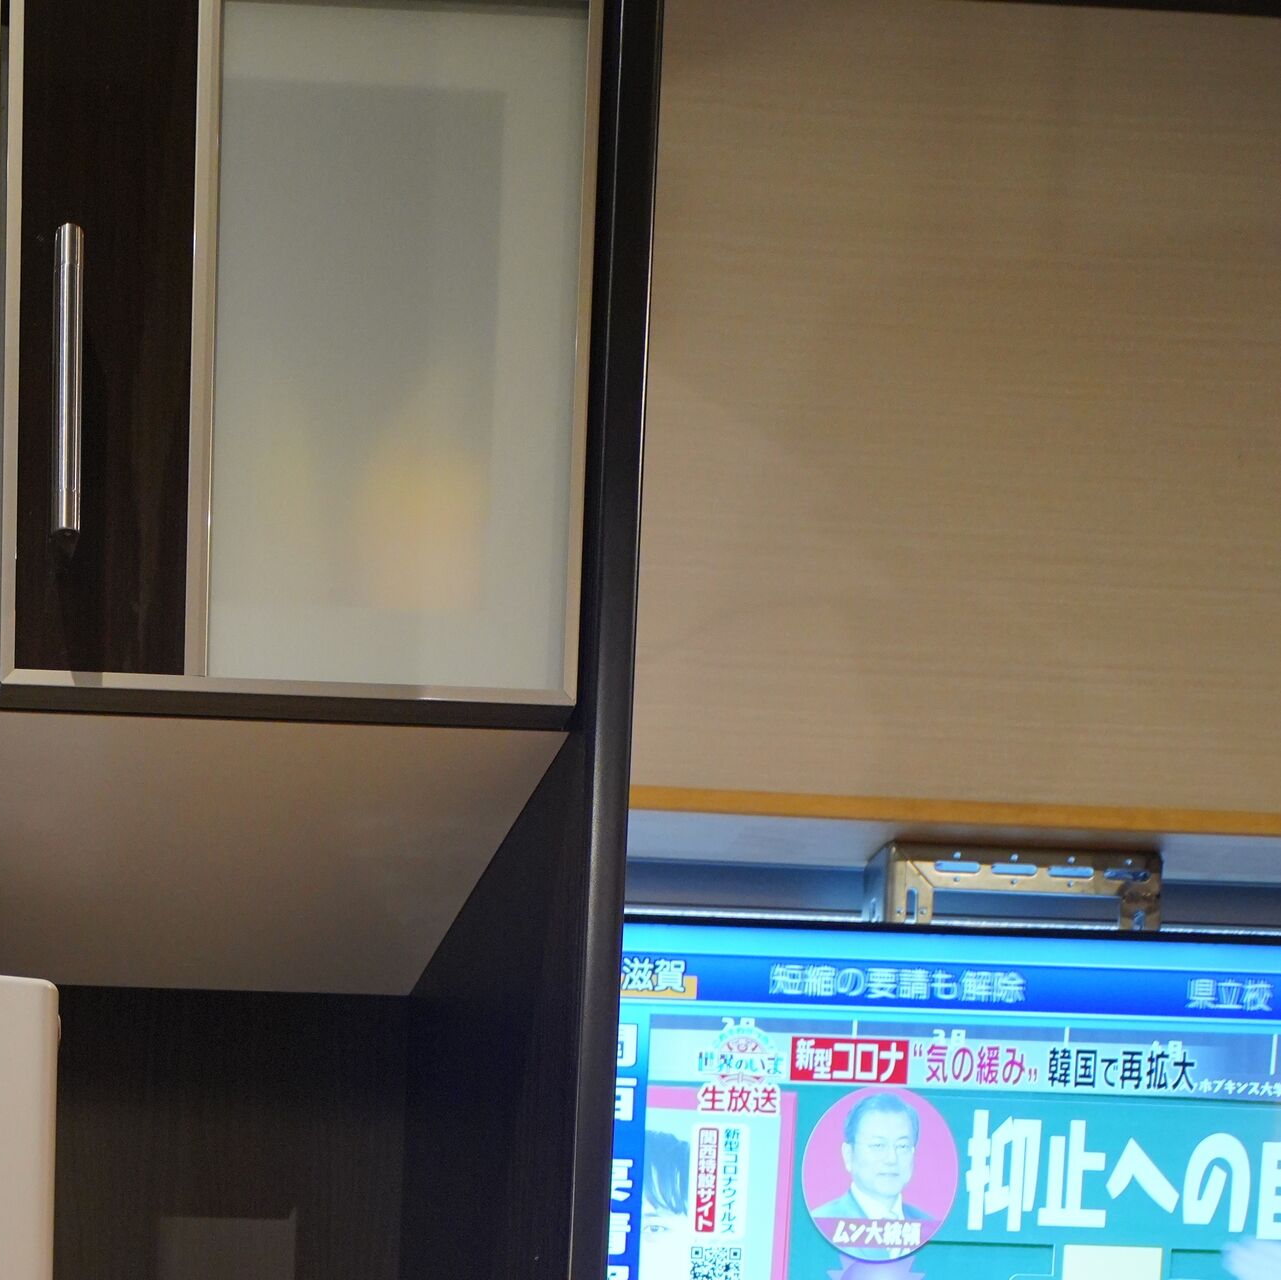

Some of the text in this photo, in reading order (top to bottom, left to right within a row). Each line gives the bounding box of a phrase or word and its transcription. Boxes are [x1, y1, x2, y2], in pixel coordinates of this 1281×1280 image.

[621, 957, 1273, 1012] 滋賀 短縮の要請も解除 県立校
[796, 1038, 904, 1082] 新型コロナ
[1047, 1047, 1196, 1091] 韓国で再拡大
[700, 1085, 777, 1113] 生放送
[833, 1221, 921, 1247] ムン大統領
